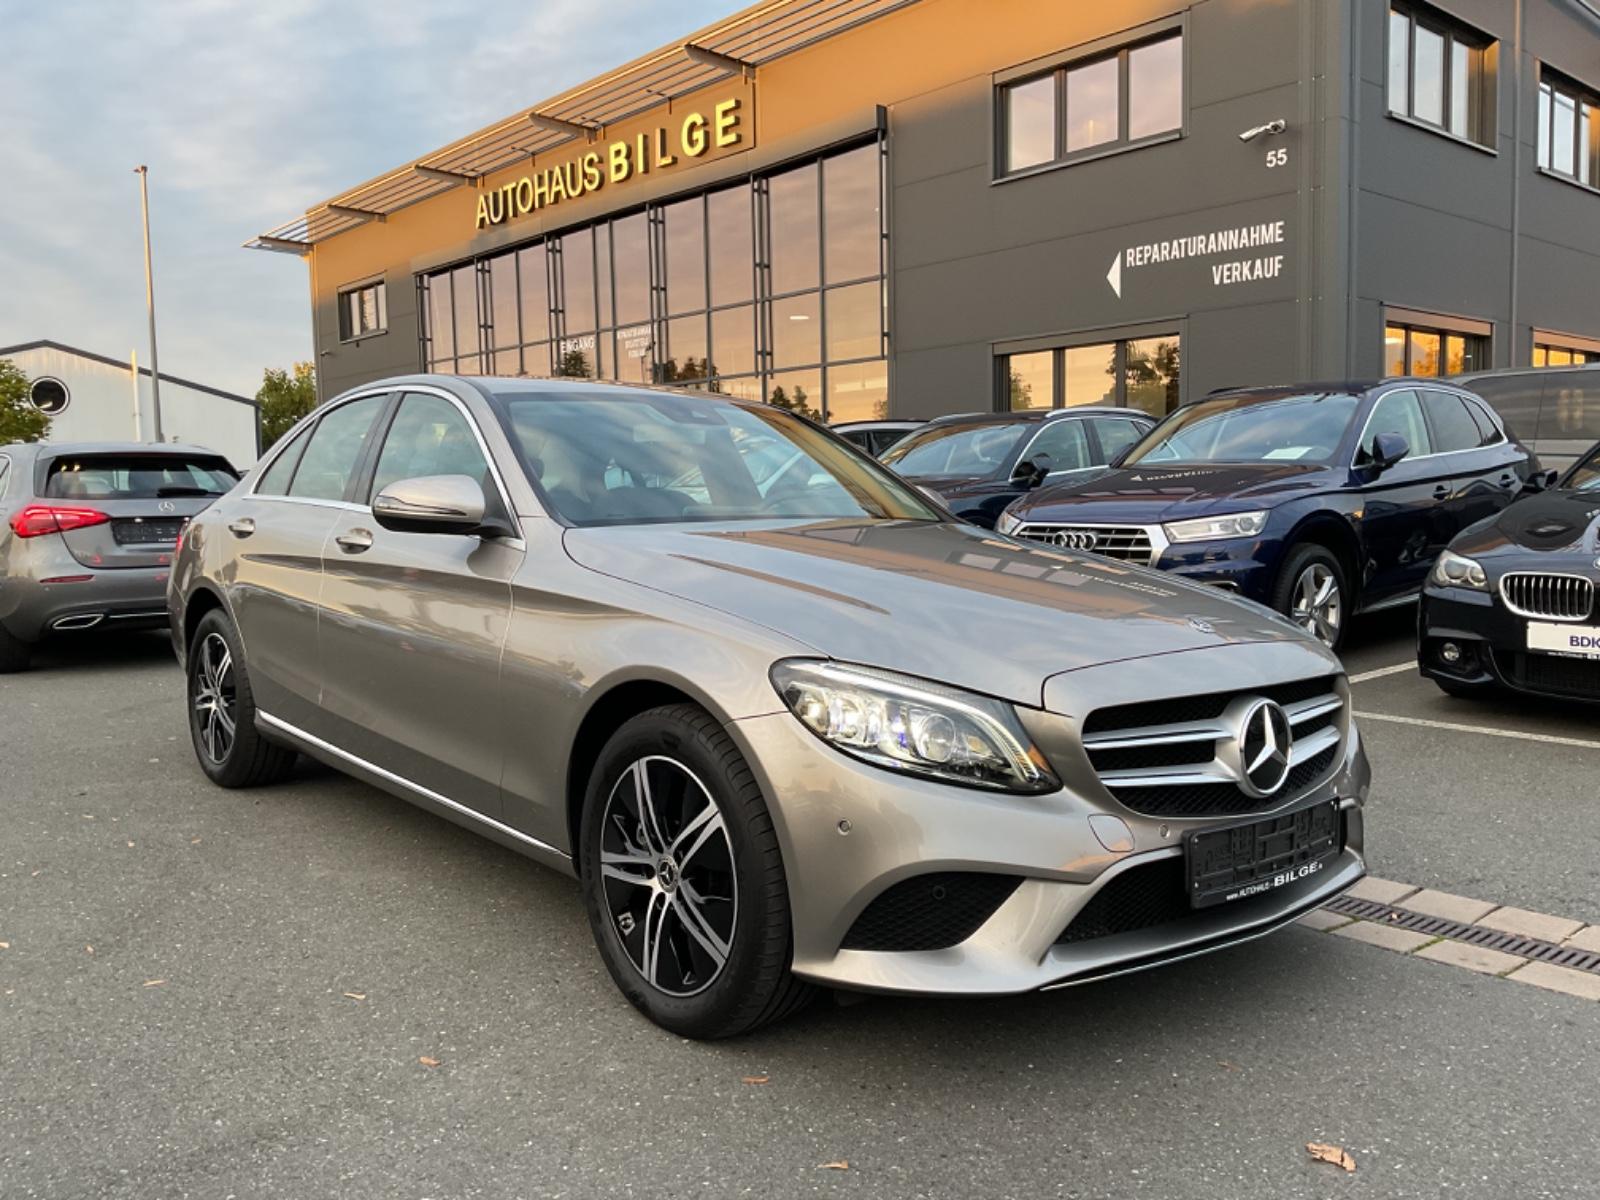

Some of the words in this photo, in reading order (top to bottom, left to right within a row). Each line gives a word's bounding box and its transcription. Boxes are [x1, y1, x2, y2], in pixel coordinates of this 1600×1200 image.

[475, 151, 601, 229] AUTOHAUS
[609, 98, 740, 183] BILGE
[1266, 149, 1288, 168] 55
[1126, 221, 1285, 268] REPARATURANNAHME
[1212, 255, 1284, 285] VERKAUF
[560, 337, 596, 354] ENGANG
